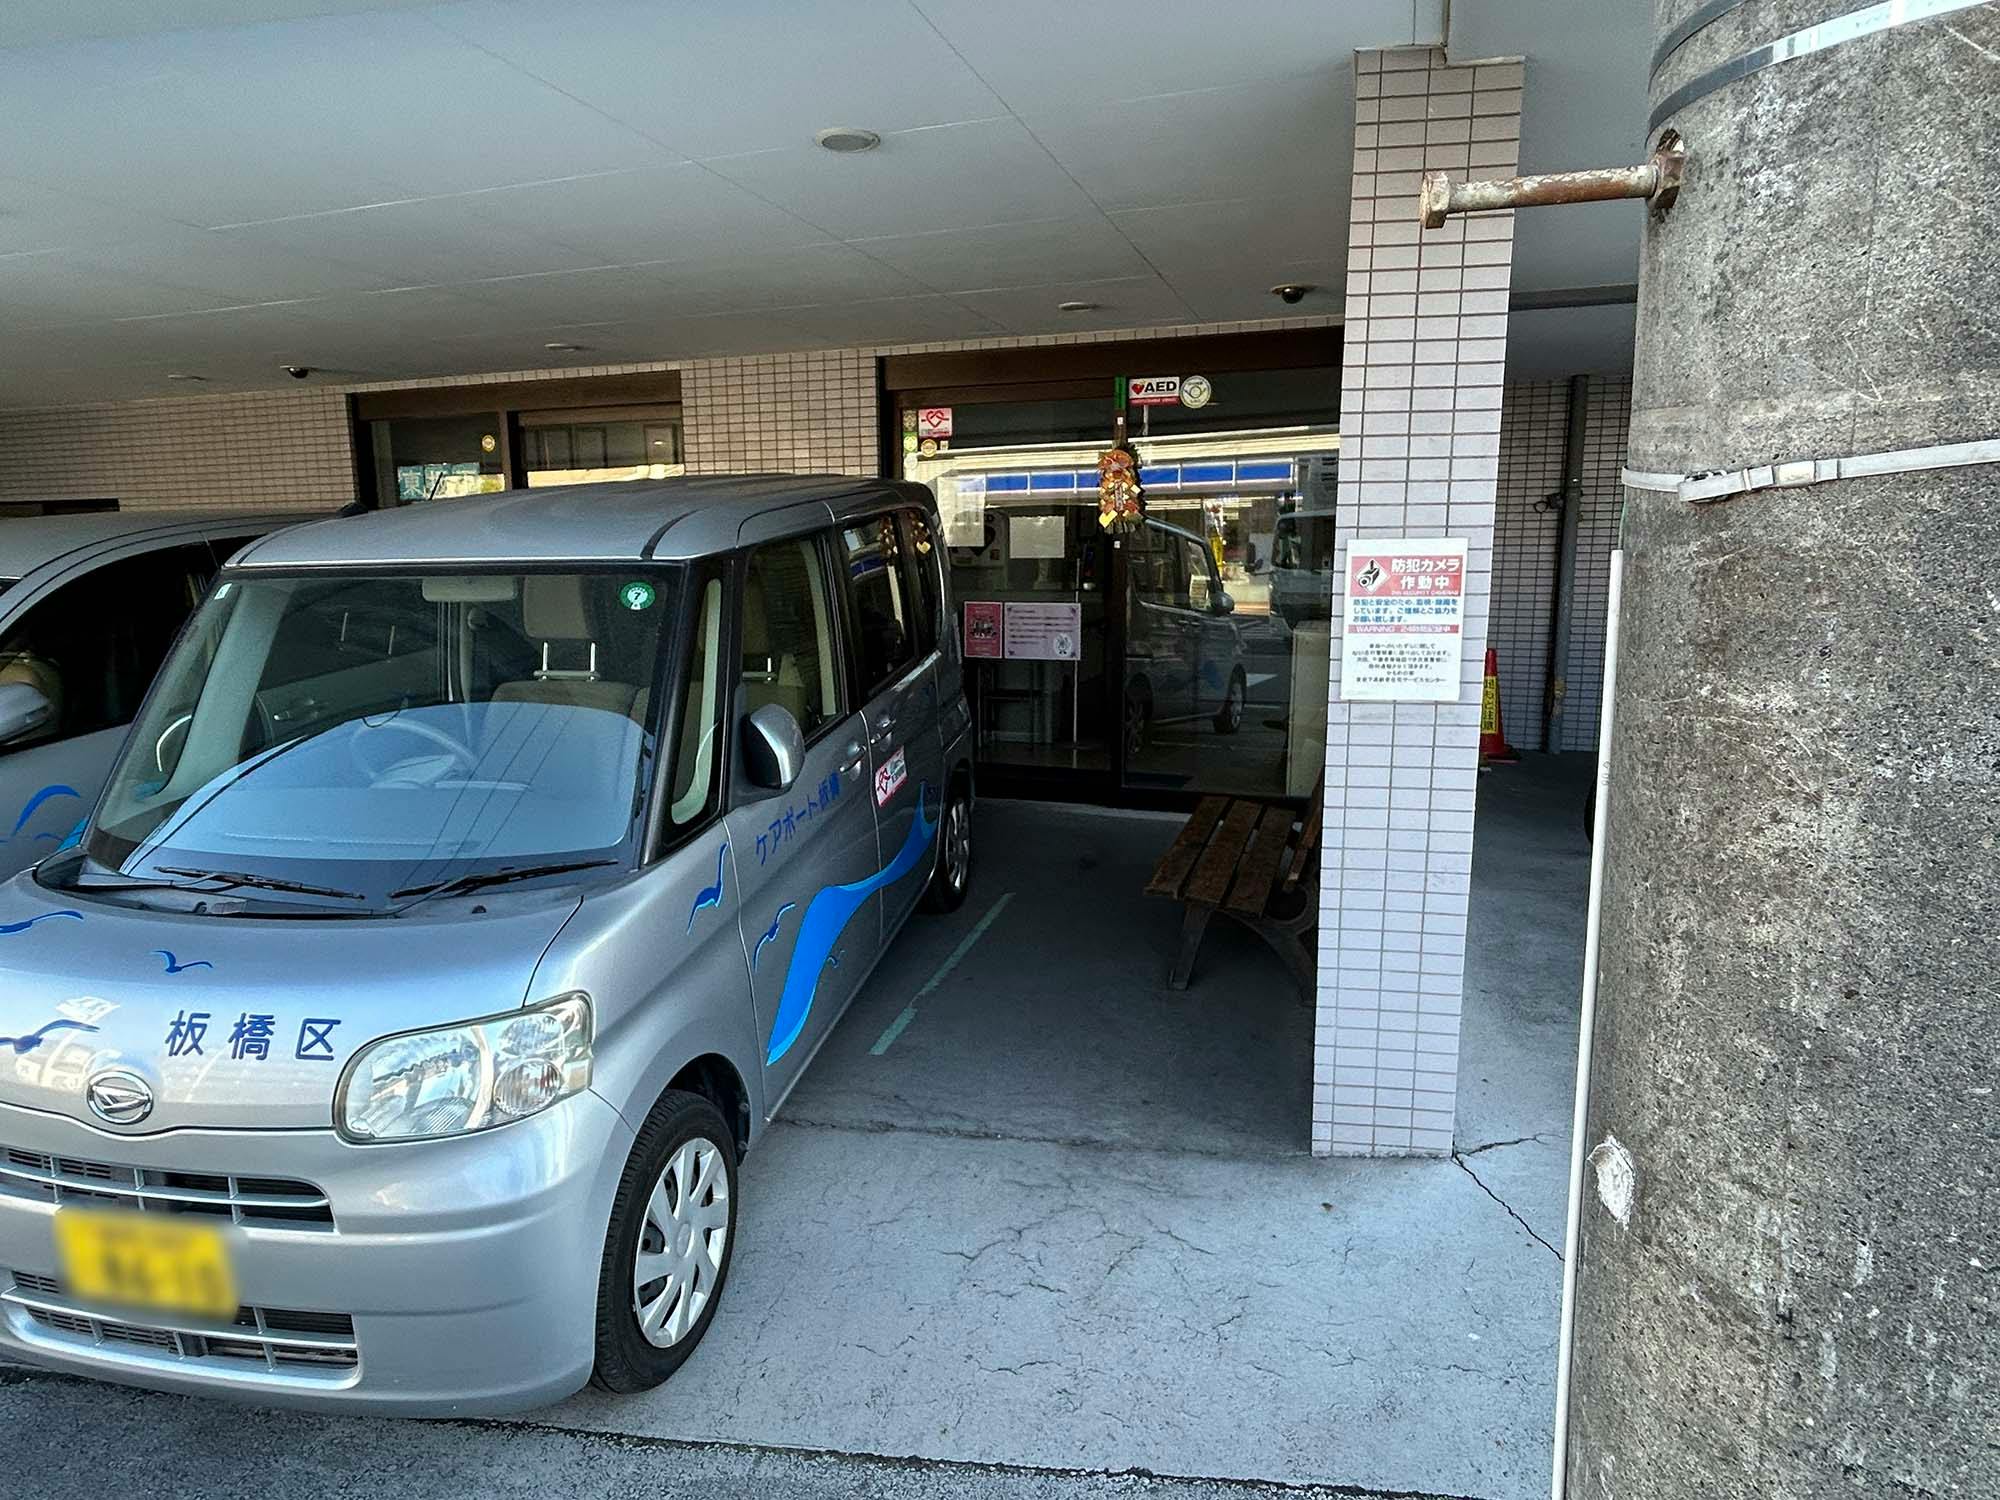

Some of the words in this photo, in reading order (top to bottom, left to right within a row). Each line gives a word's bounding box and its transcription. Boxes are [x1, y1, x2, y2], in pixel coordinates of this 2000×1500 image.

[1145, 381, 1177, 393] AED
[1391, 558, 1460, 573] 防犯カメラ
[1401, 575, 1450, 590] 作動中
[634, 591, 642, 601] 7
[1355, 625, 1396, 633] WARNING
[165, 1010, 342, 1061] 板橋区
